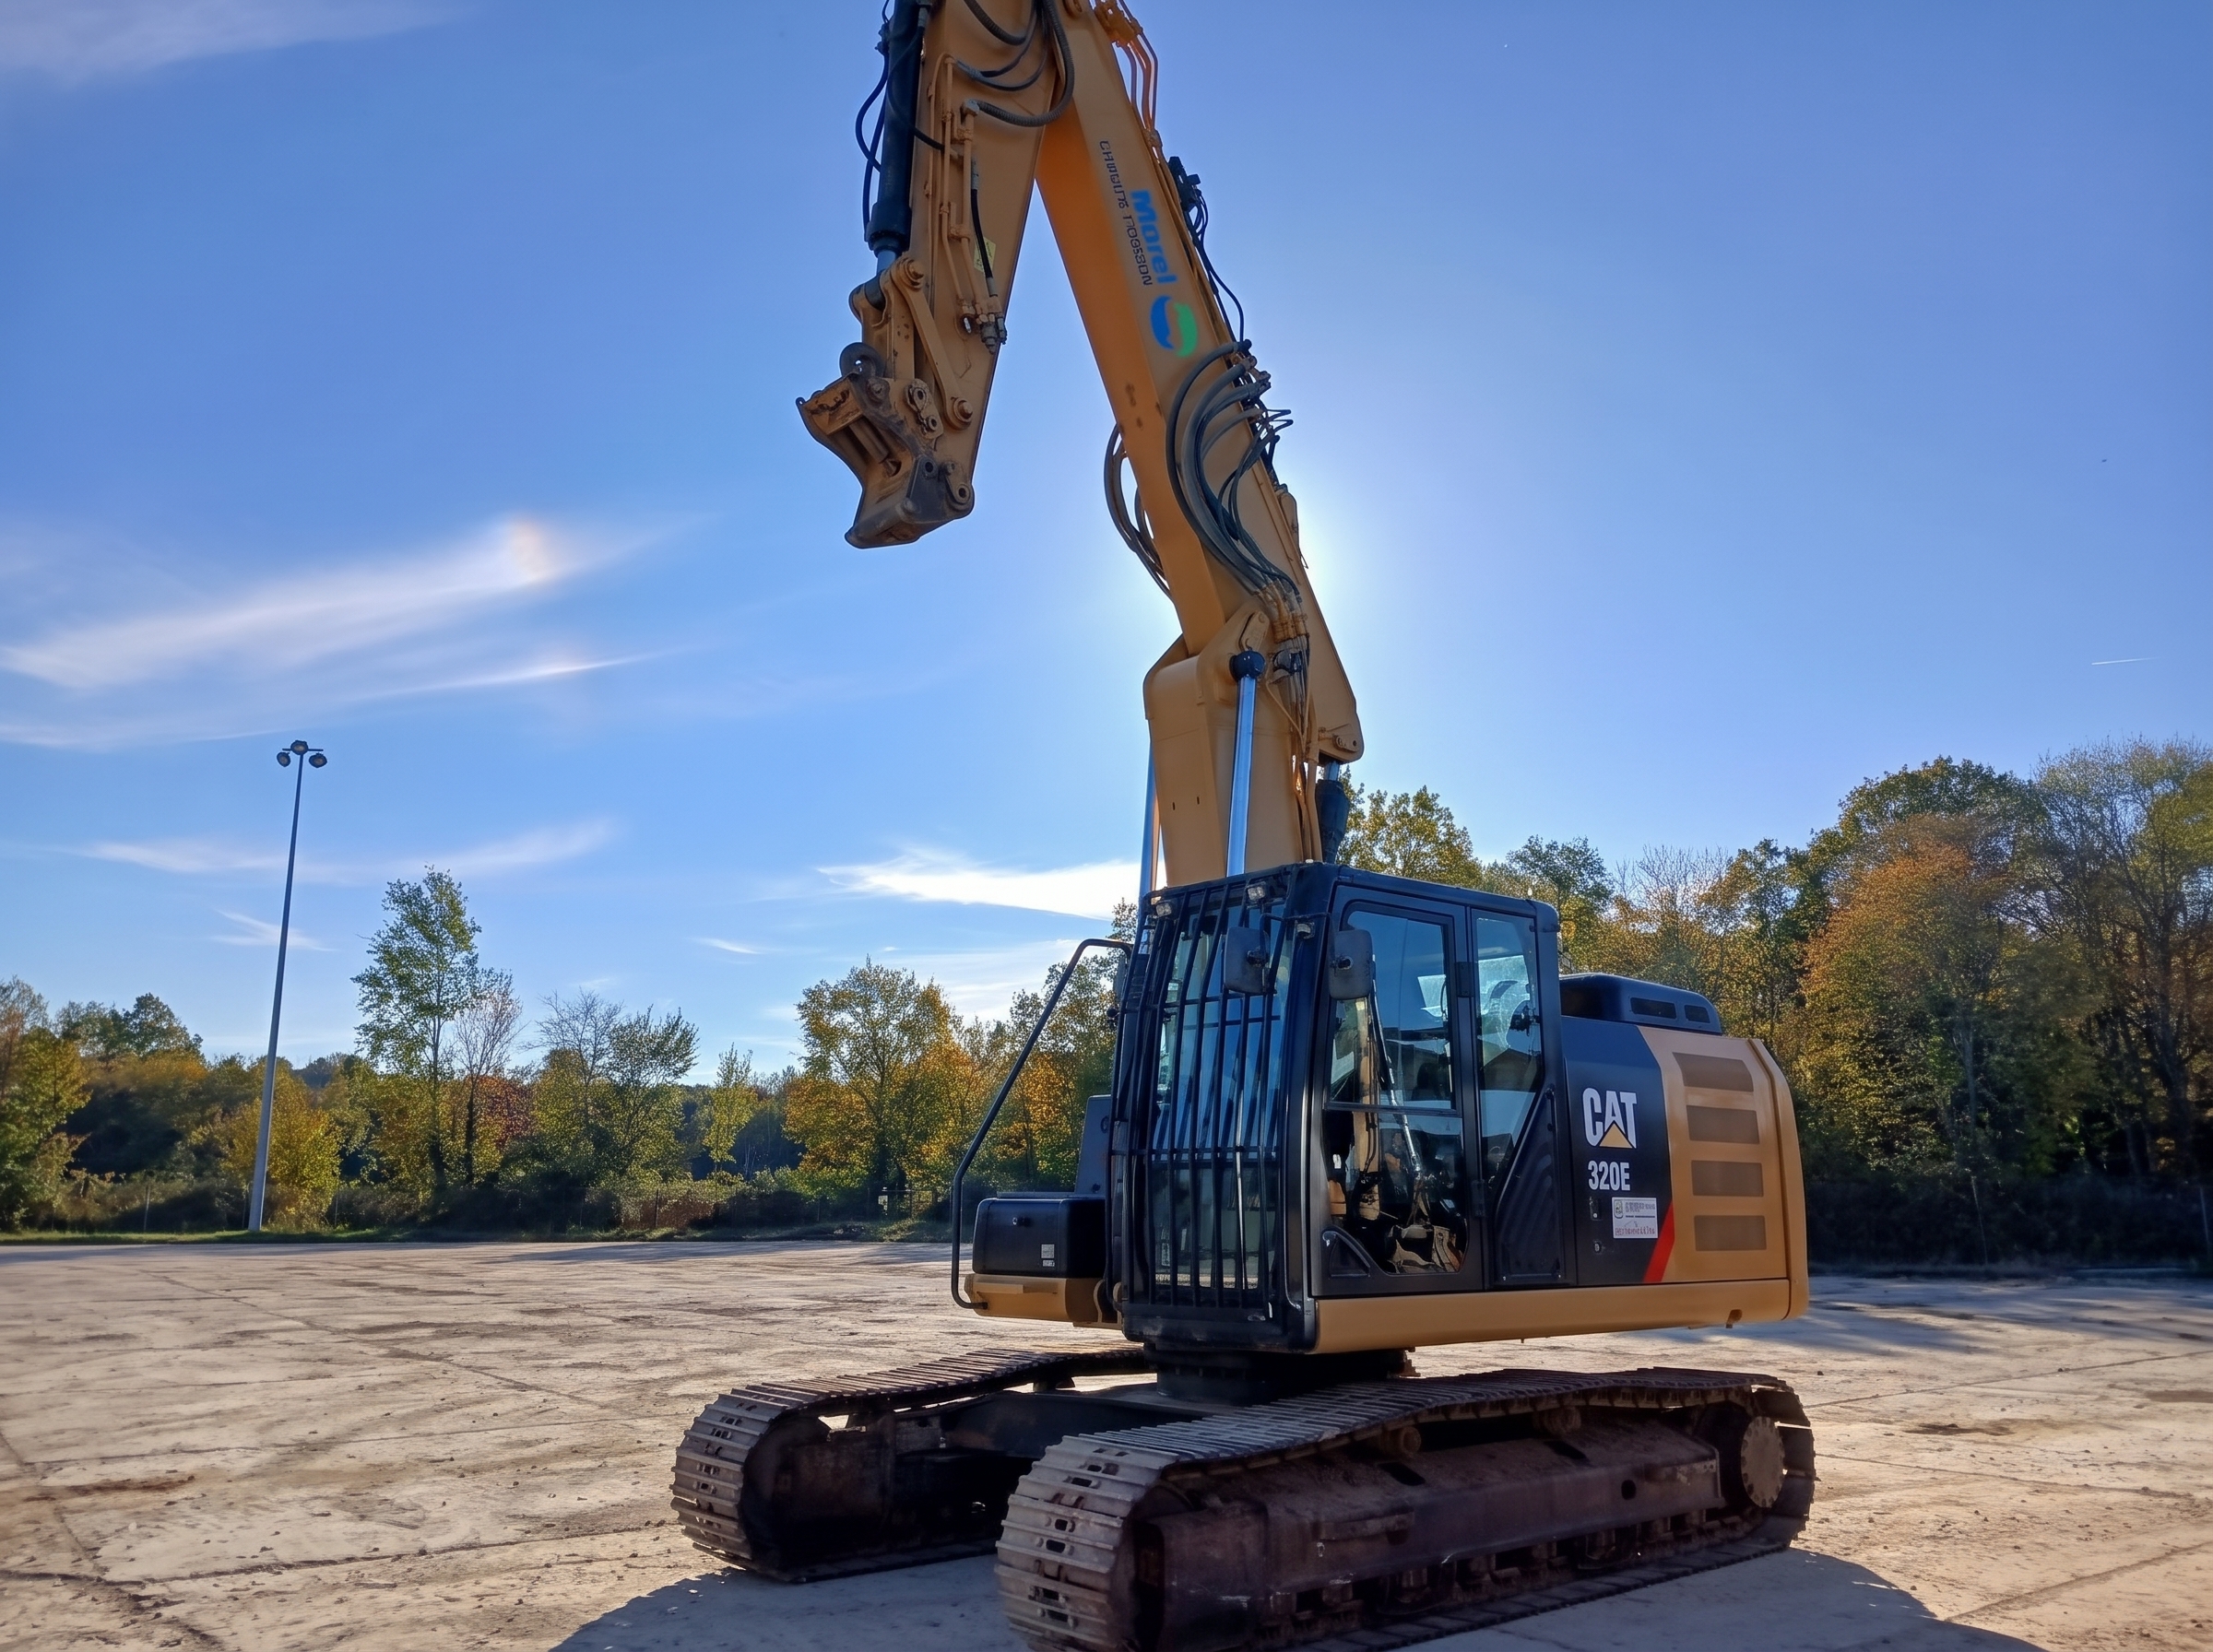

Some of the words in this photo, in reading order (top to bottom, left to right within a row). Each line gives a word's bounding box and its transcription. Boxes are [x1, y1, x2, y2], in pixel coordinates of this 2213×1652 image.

[1130, 190, 1178, 284] Morel
[1582, 1088, 1637, 1149] CAT
[1588, 1161, 1630, 1191] 320E
